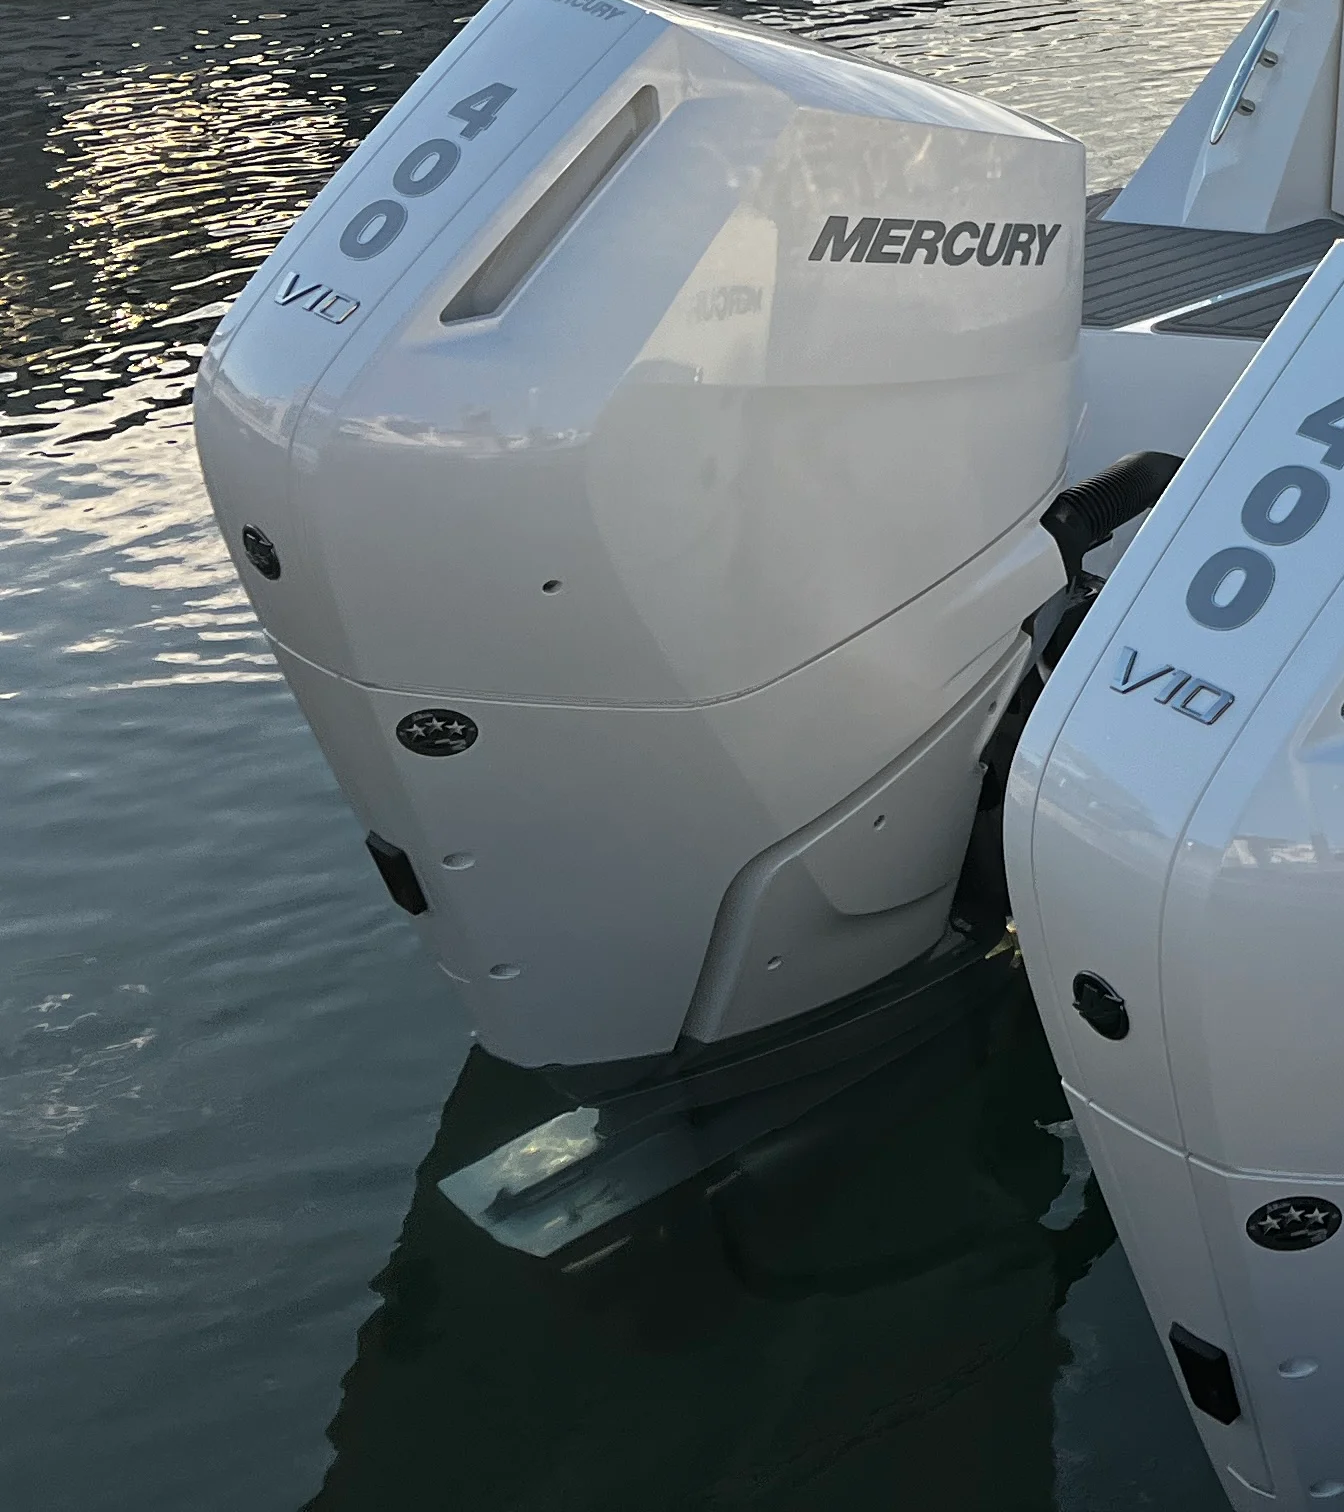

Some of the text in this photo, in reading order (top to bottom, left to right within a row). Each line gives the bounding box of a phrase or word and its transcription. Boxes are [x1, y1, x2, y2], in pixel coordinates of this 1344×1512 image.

[339, 82, 518, 262] 400
[808, 216, 1062, 266] MERCURY
[274, 271, 361, 325] V10
[1110, 646, 1236, 726] V10
